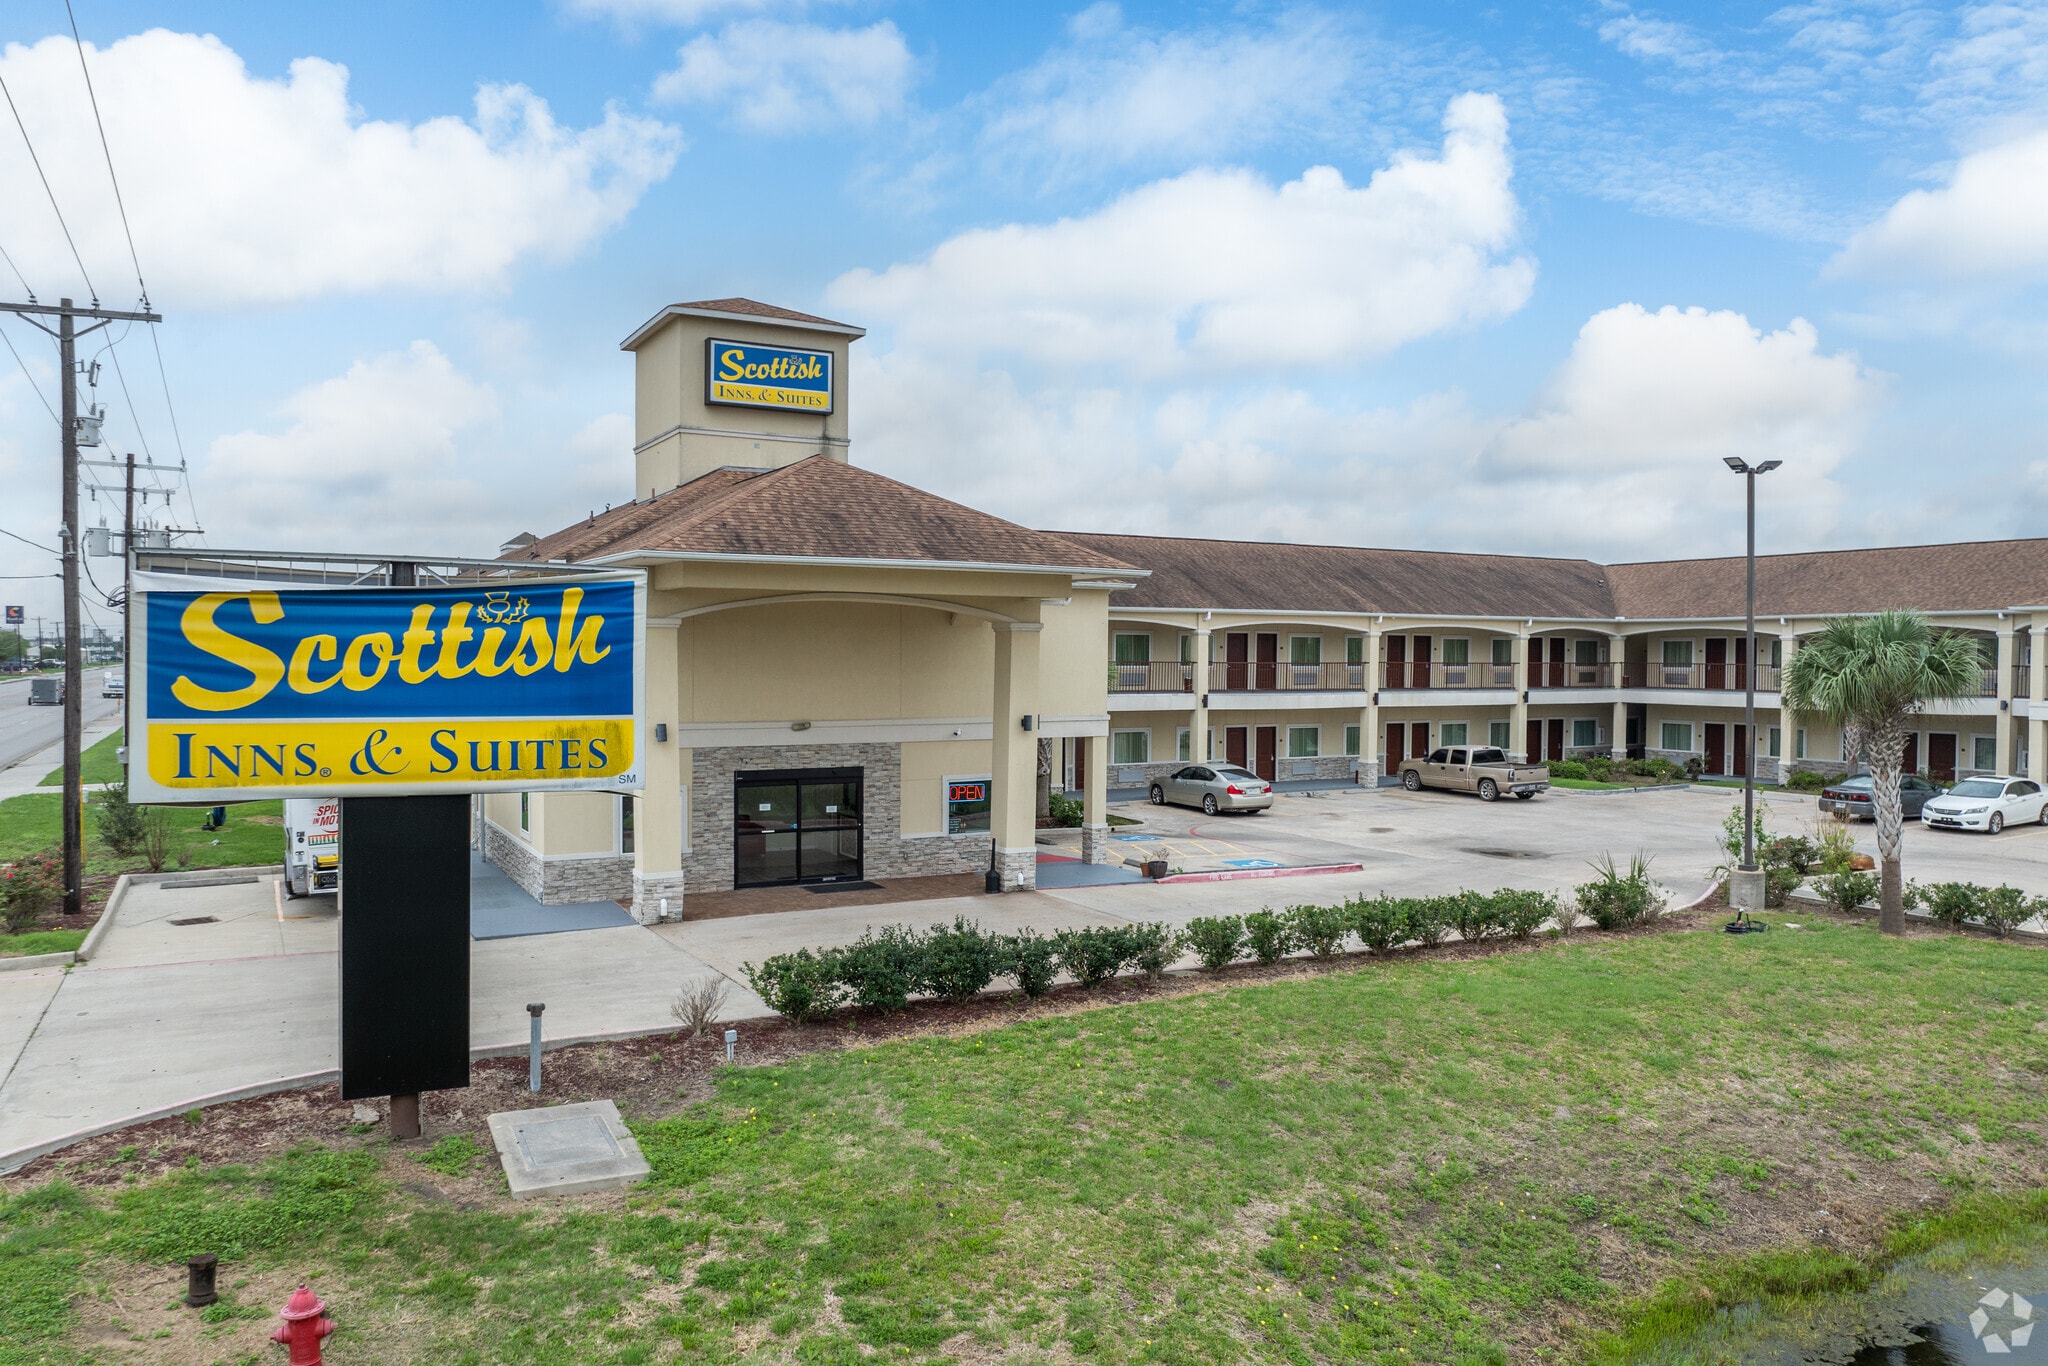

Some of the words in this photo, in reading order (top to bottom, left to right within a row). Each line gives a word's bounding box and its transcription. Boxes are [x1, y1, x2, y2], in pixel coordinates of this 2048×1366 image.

[719, 350, 823, 381] Scottish
[758, 389, 772, 401] &
[777, 391, 822, 406] SUITES
[171, 587, 611, 712] Scottish
[350, 729, 411, 775] &
[430, 729, 608, 773] SUITES
[618, 774, 636, 784] SM
[950, 785, 984, 800] OPEN
